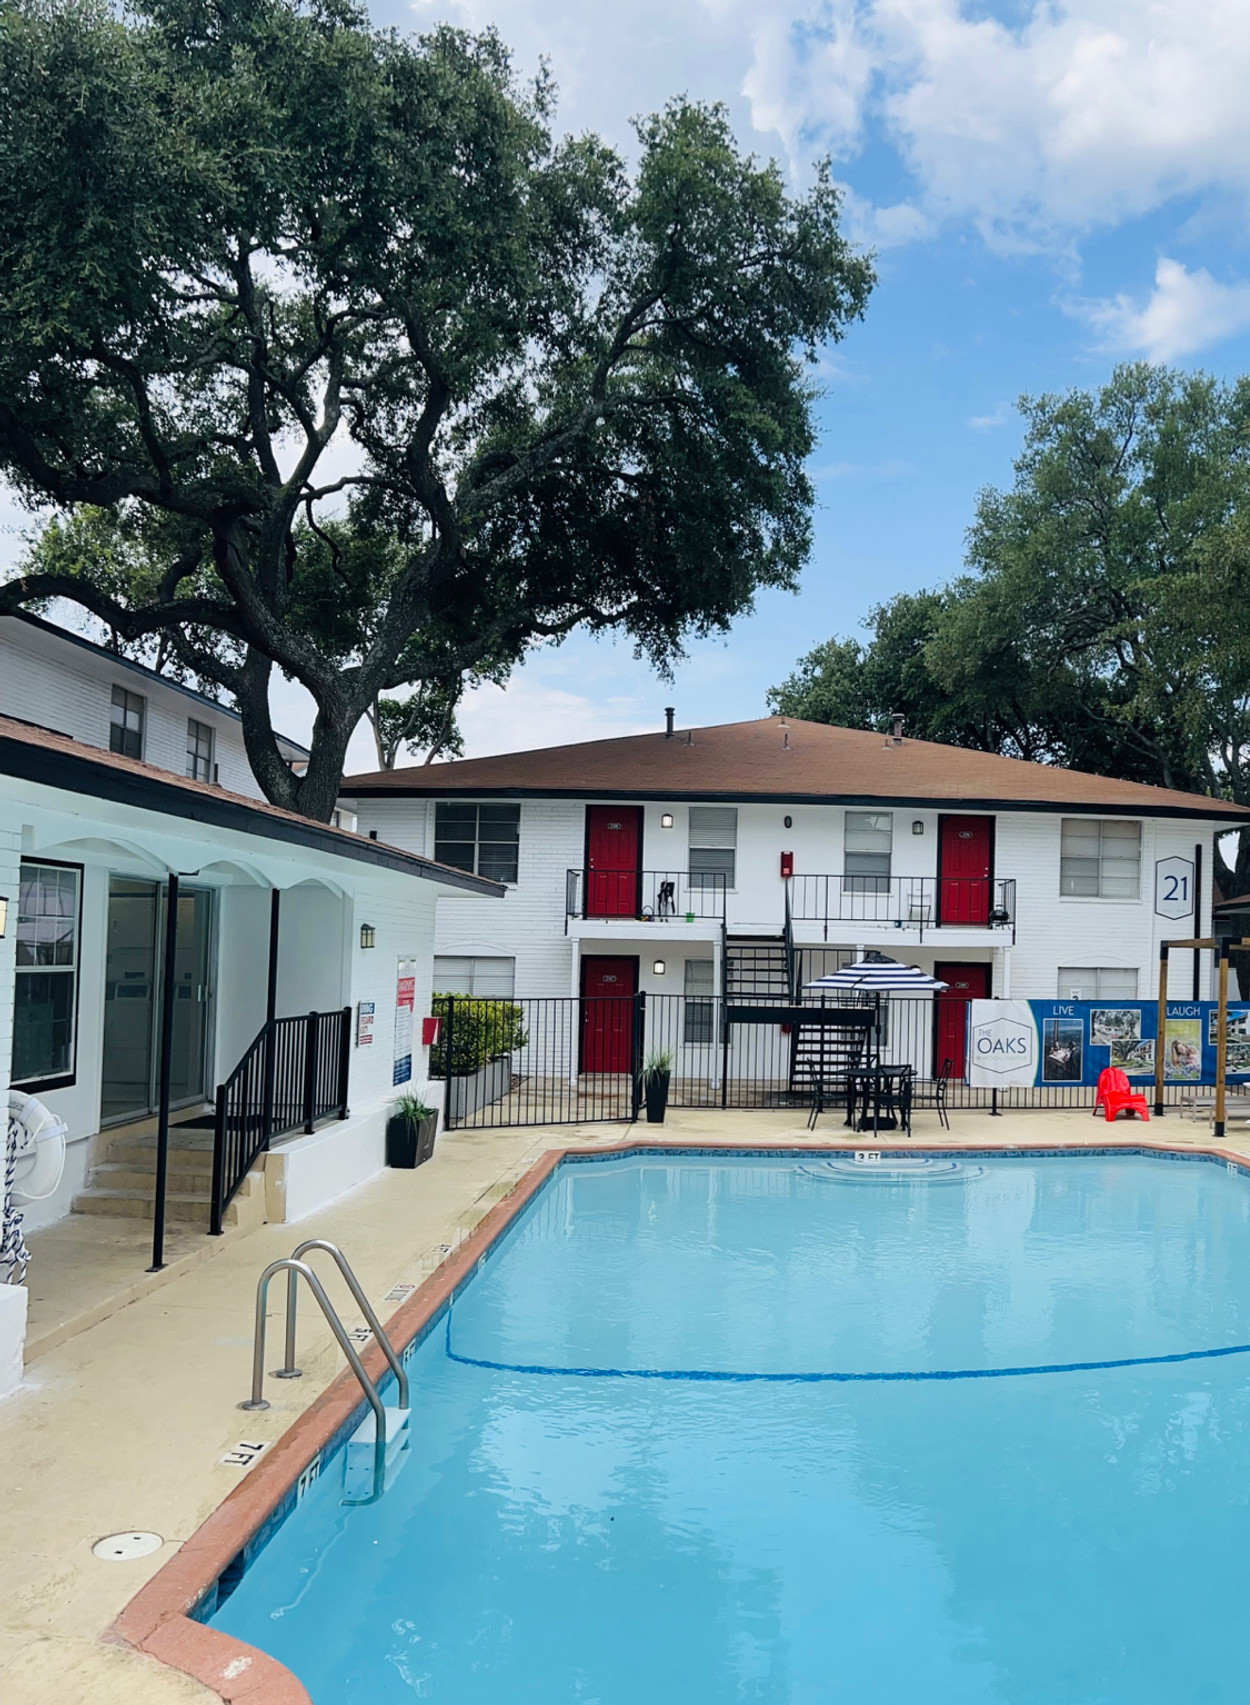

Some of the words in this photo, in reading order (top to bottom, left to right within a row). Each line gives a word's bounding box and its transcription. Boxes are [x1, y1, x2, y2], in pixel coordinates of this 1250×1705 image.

[1163, 875, 1187, 901] 21
[1053, 1005, 1075, 1016] LIVE
[1166, 1006, 1200, 1016] LAUGH
[977, 1037, 1027, 1054] OAKS
[868, 1152, 880, 1160] FT
[347, 1333, 369, 1342] FT
[239, 1443, 265, 1451] 7
[224, 1452, 256, 1466] FT
[300, 1474, 307, 1499] 7
[308, 1460, 320, 1489] FT
